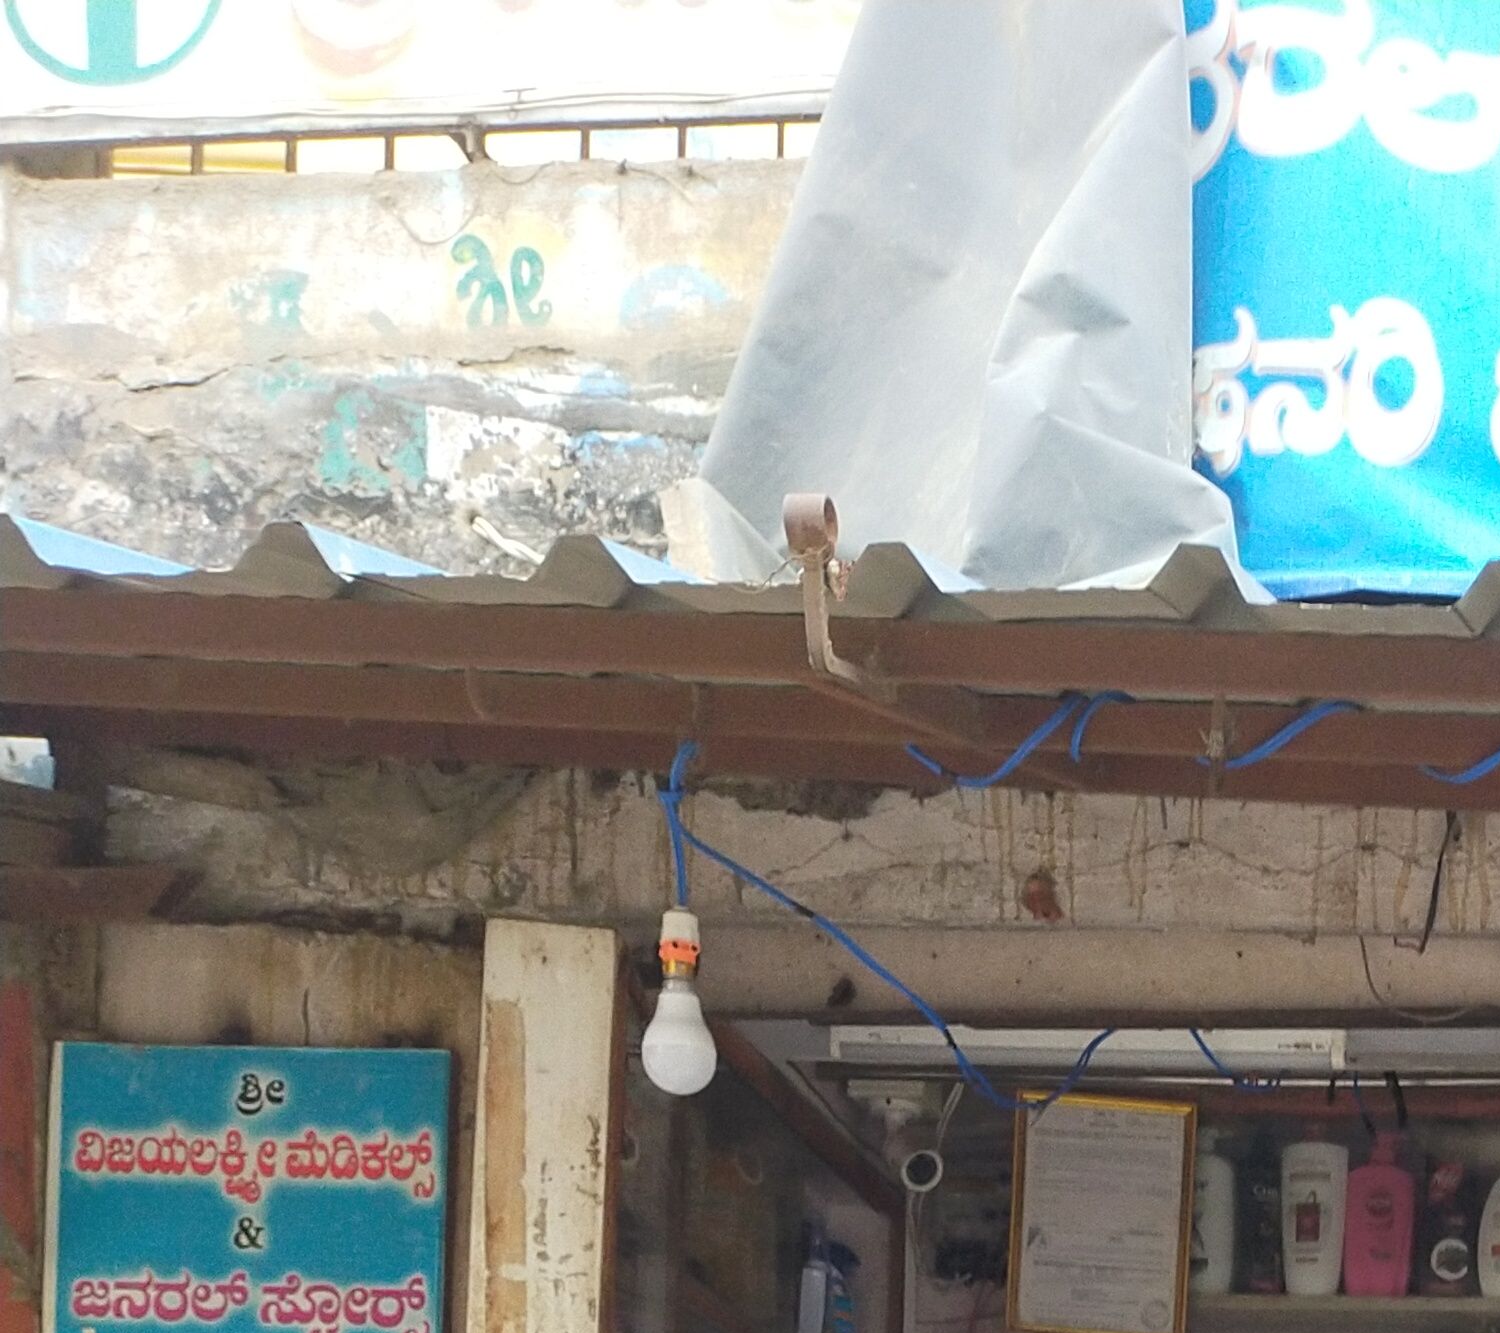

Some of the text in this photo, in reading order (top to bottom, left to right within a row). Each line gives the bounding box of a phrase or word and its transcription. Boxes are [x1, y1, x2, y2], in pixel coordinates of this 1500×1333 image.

[236, 1072, 285, 1116] ಶ್ರೀ
[285, 1130, 435, 1199] ಮೆಡಿಕಲ್ಸ್
[233, 1217, 264, 1250] &
[71, 1268, 249, 1322] ಜನರಲ್
